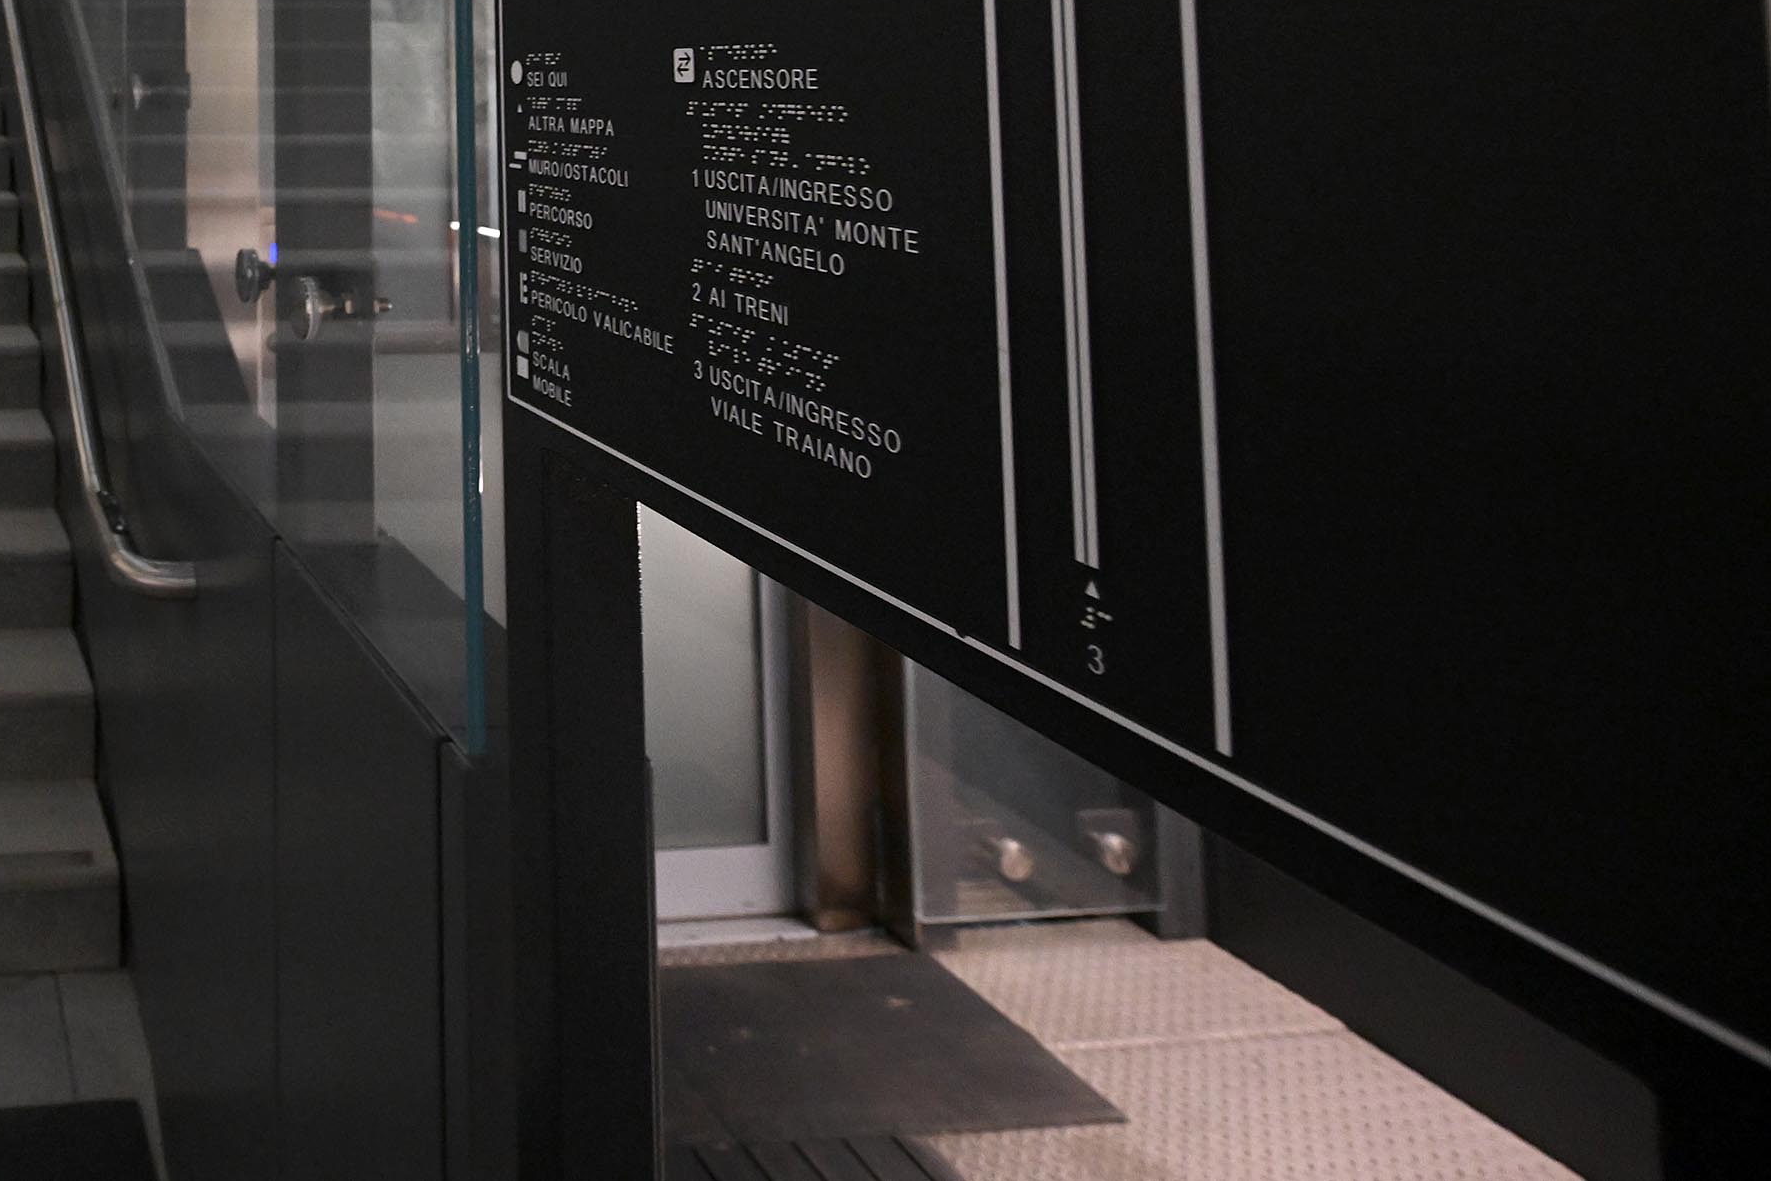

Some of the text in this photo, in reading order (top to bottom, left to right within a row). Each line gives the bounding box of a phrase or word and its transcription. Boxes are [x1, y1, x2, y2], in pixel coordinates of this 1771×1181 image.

[526, 71, 568, 88] SEI QUI
[702, 68, 819, 90] ASCENSORE
[528, 115, 615, 137] ALTRA MAPPA
[528, 158, 629, 188] MURO/OSTACOLI
[691, 169, 894, 212] 1 USCITA/INGRESSO
[529, 202, 593, 230] PERCORSO
[705, 199, 920, 254] UNIVERSITA' MONTE
[530, 246, 583, 274] SERVIZIO
[706, 229, 845, 276] SANT'ANGELO
[692, 282, 789, 326] 2 AI TRENI
[531, 289, 674, 355] PERICOLO VALICABILE
[532, 351, 571, 382] SCALA
[533, 374, 573, 407] MOBILE
[693, 360, 901, 454] 3 USCITA/INGRESSO
[710, 396, 872, 479] VIALE TRAIANO
[1087, 644, 1106, 676] 3
